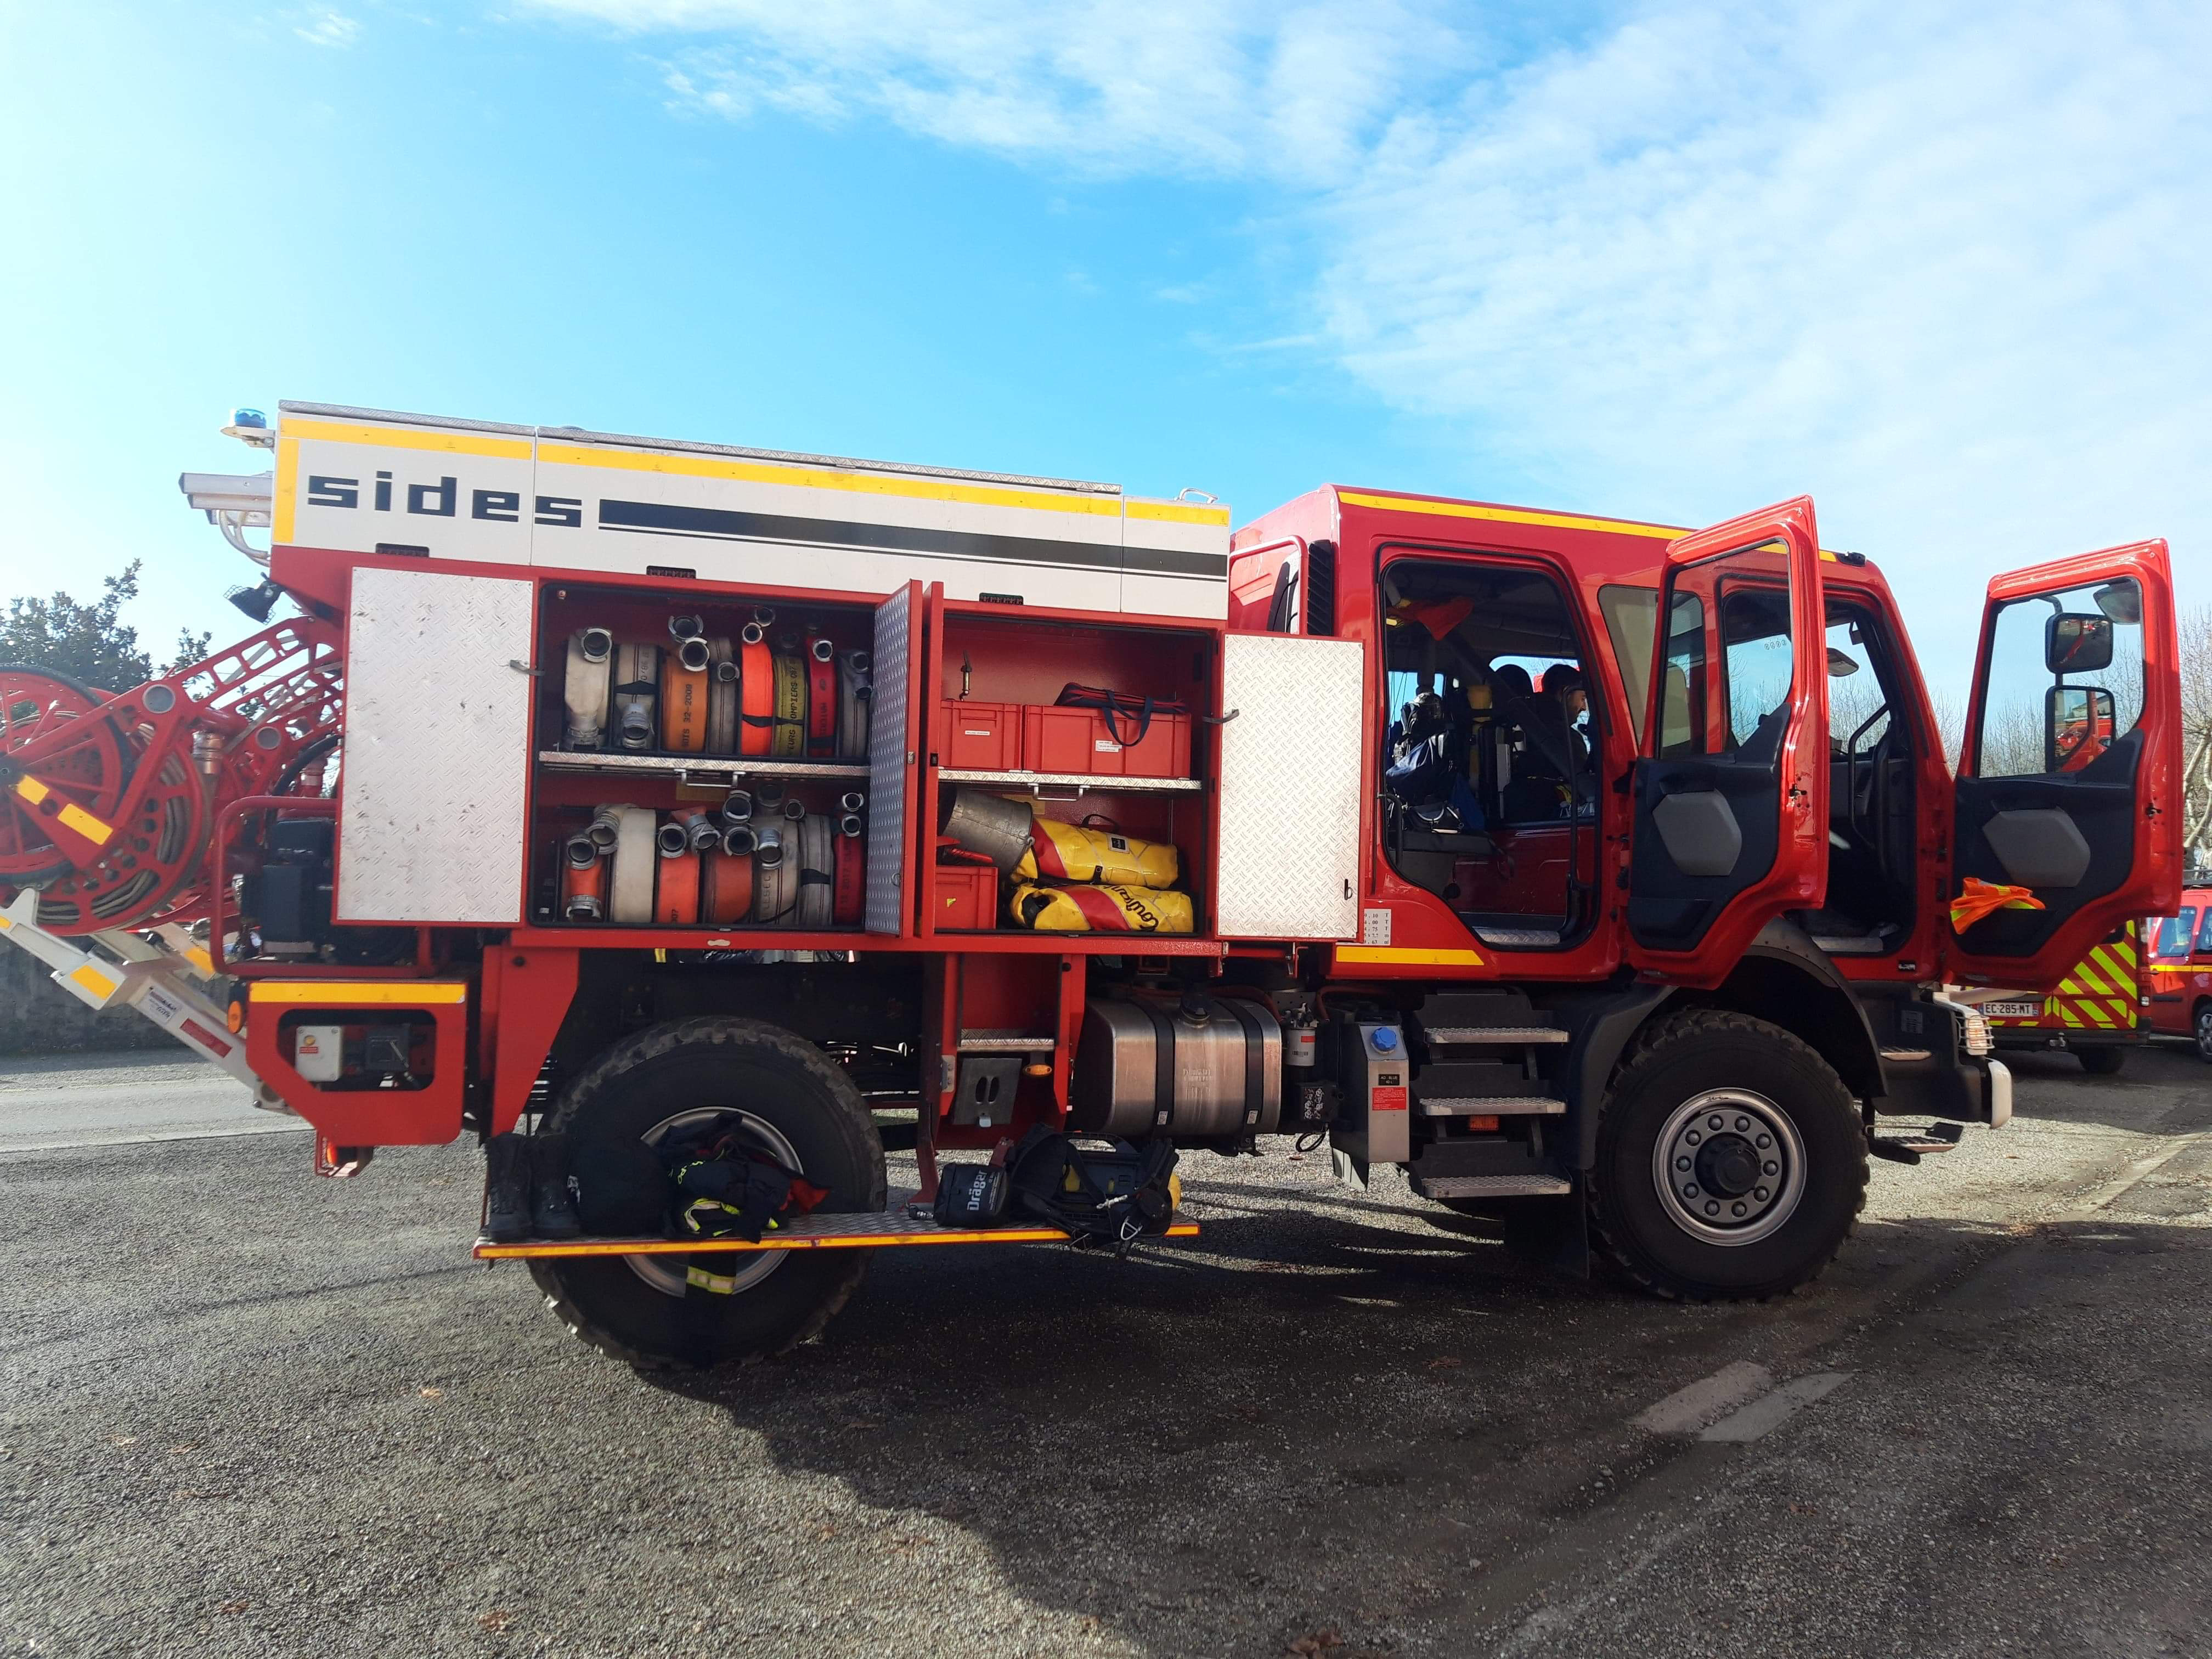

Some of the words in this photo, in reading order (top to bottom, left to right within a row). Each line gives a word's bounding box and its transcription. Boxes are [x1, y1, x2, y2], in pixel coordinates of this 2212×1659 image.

[308, 470, 582, 528] sides
[790, 681, 799, 721] OMPIERS
[787, 729, 796, 751] EURS
[1985, 1003, 2030, 1014] EC-285-MT
[967, 1170, 988, 1211] Dräger
